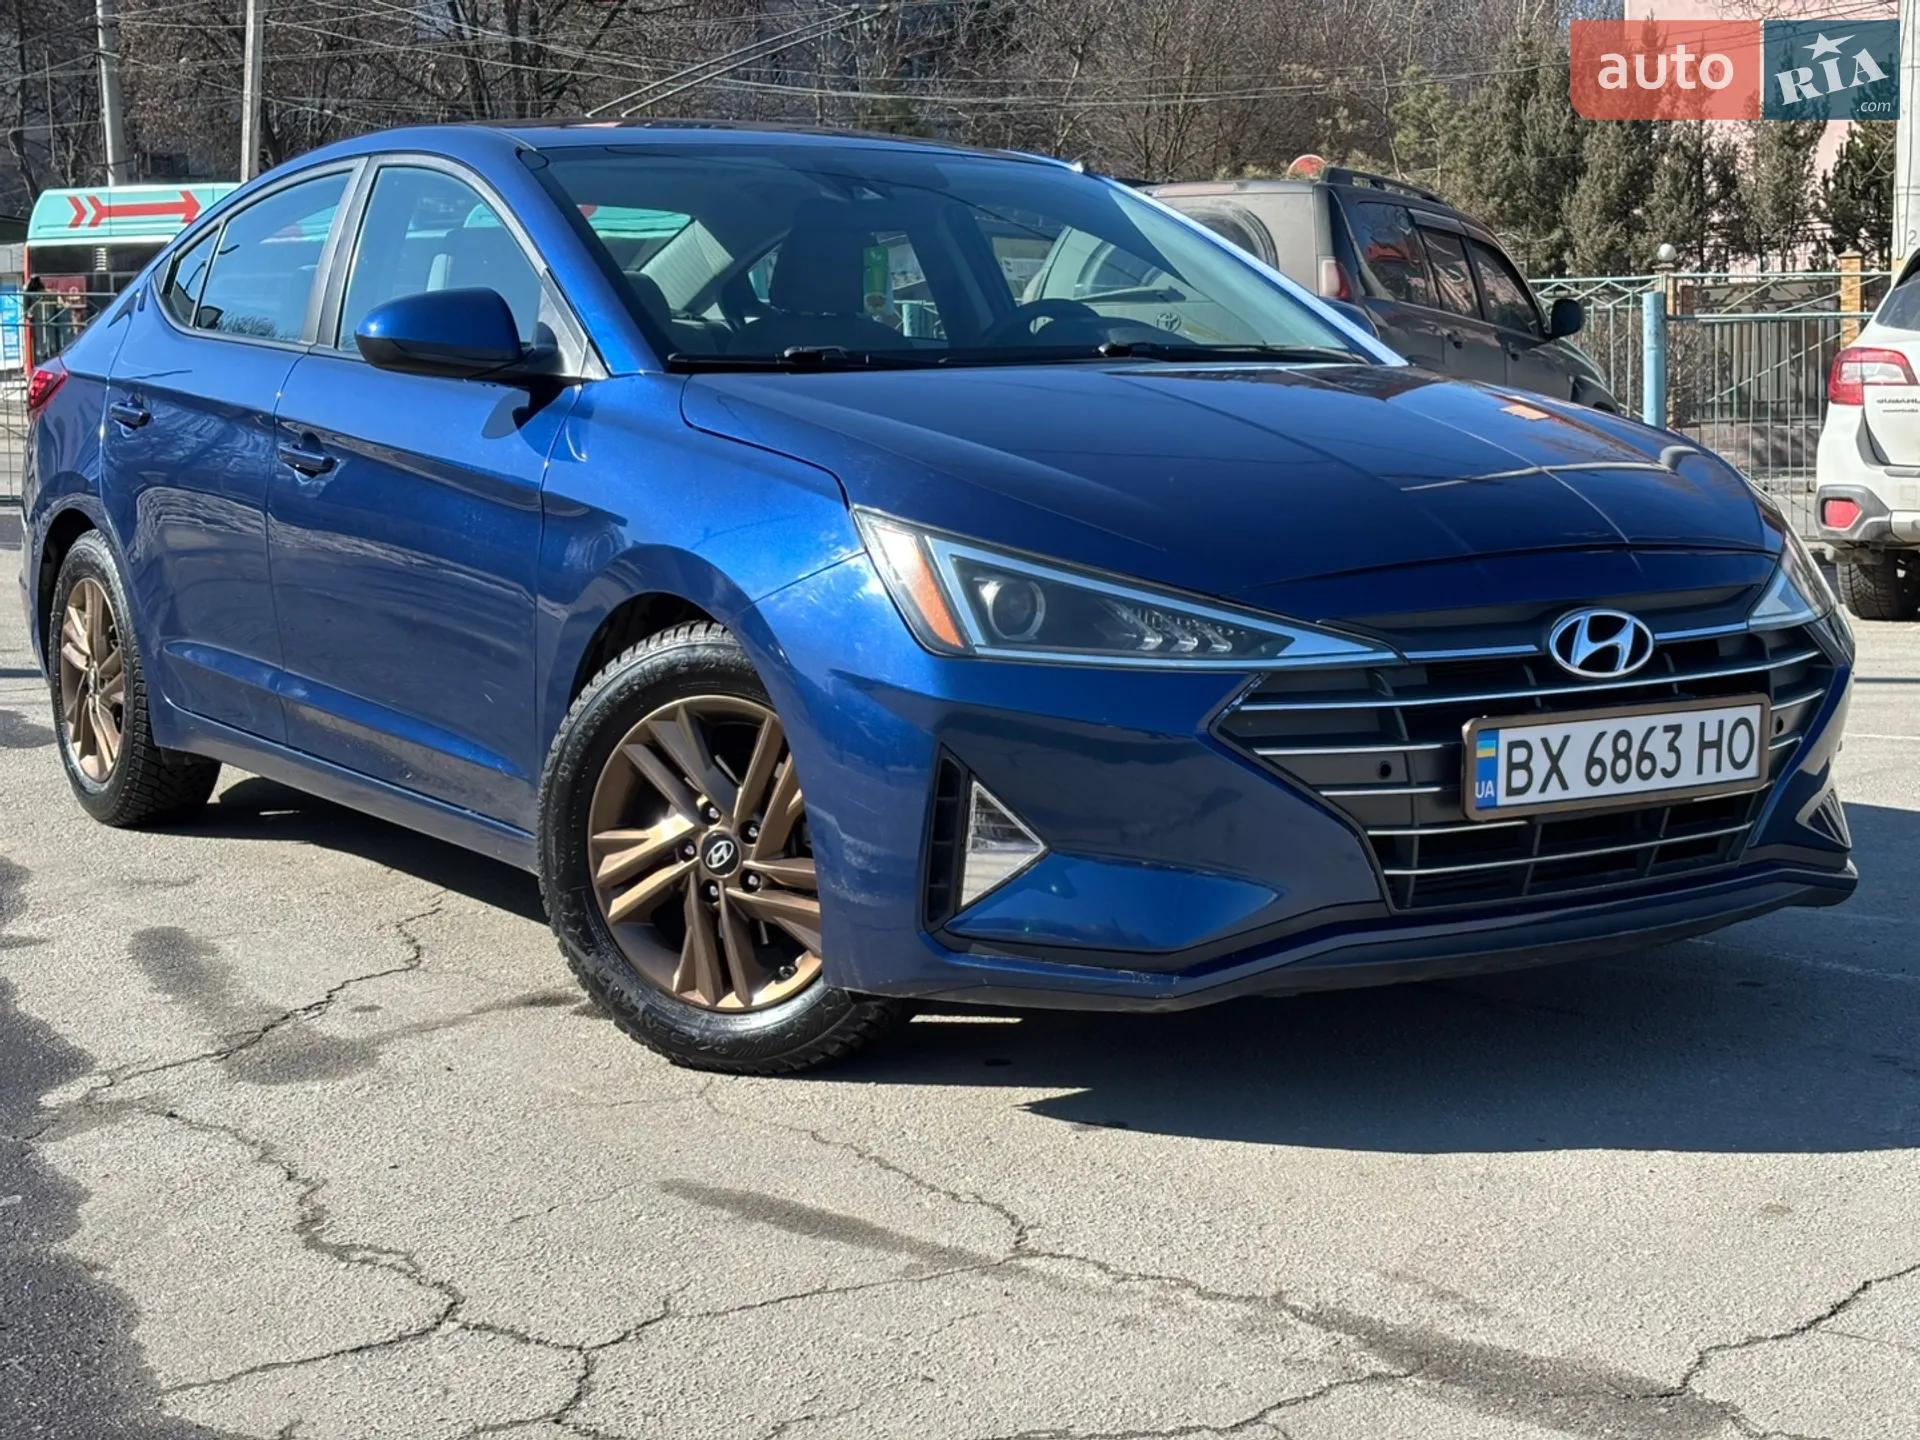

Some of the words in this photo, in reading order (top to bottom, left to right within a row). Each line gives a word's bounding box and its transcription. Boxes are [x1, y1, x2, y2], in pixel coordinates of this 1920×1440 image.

[1505, 734, 1571, 797] BX
[1585, 723, 1682, 787] 6863
[1697, 717, 1755, 775] HO
[1475, 780, 1495, 798] UA
